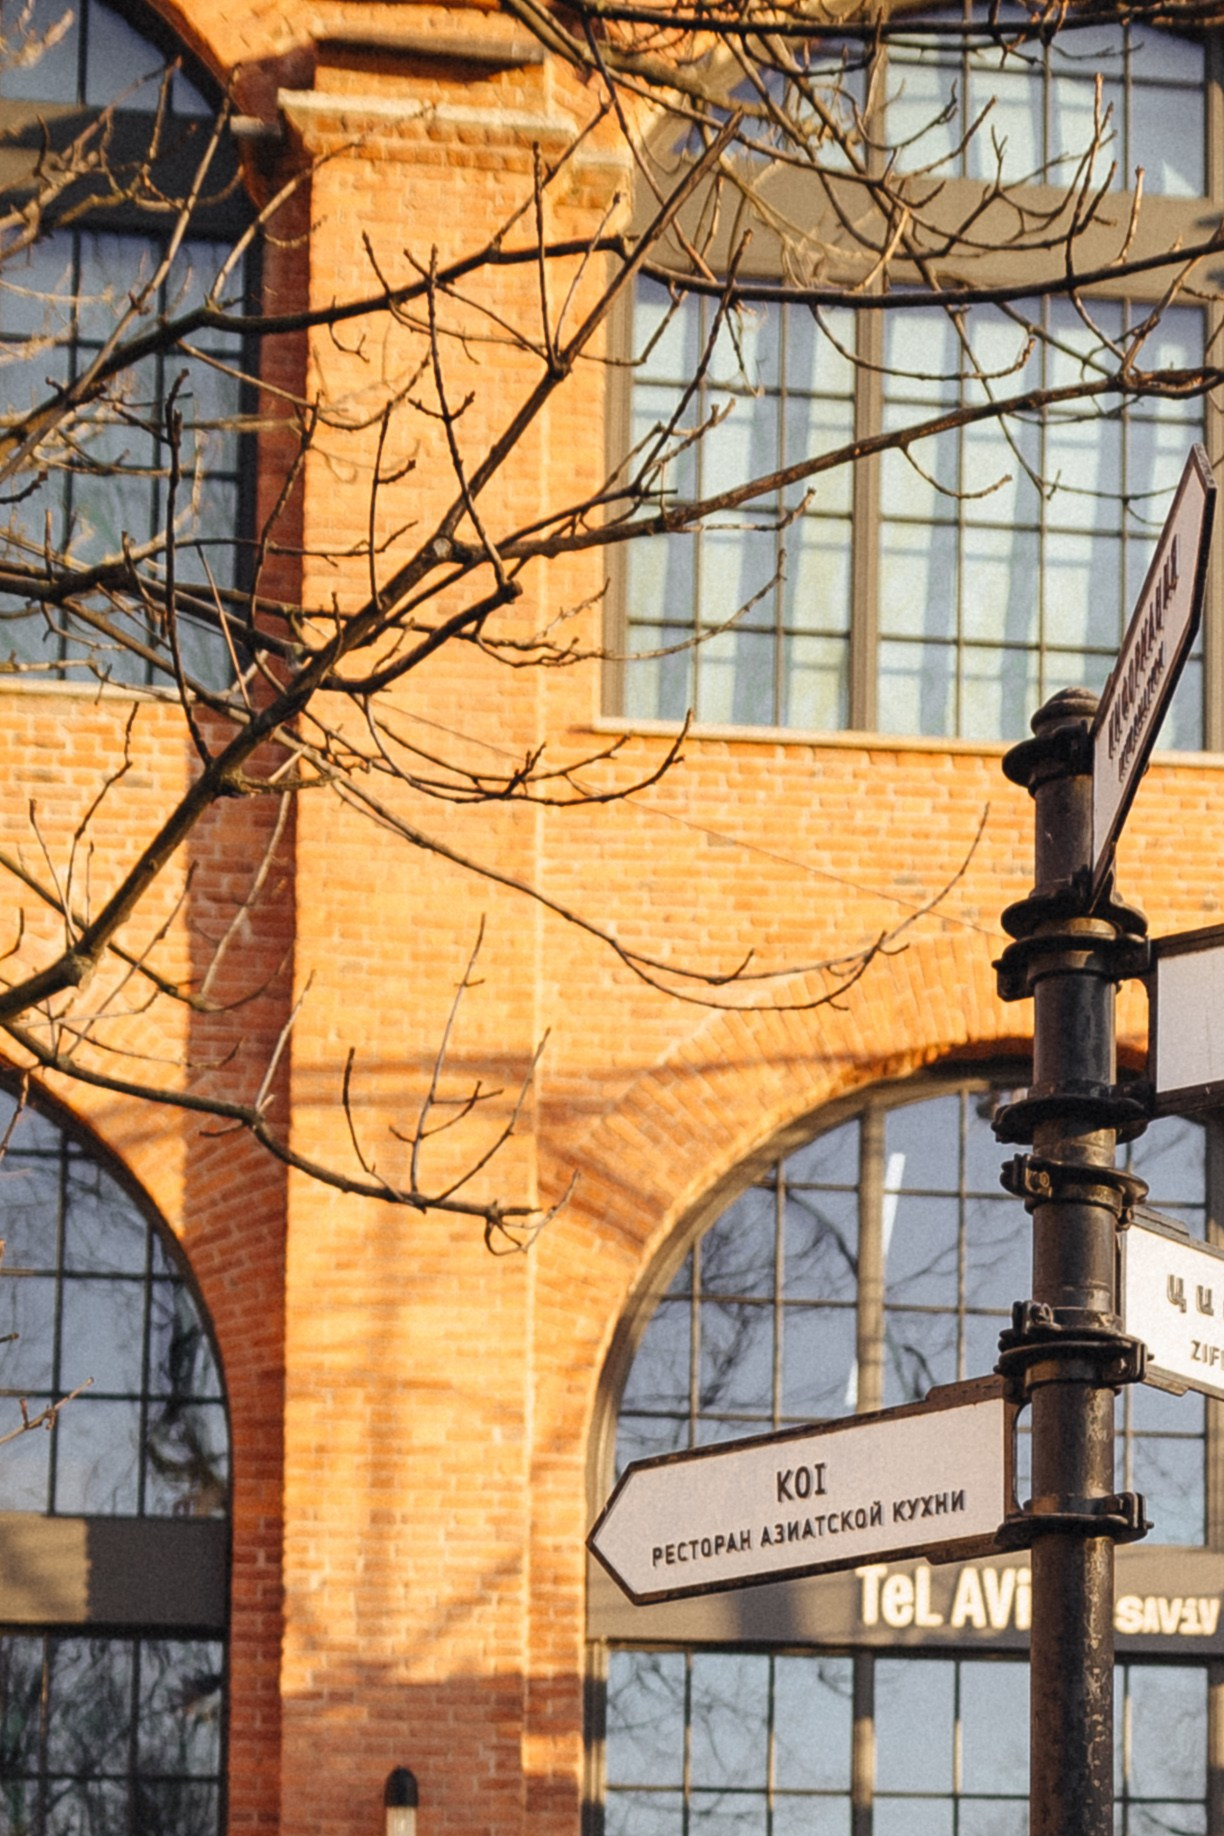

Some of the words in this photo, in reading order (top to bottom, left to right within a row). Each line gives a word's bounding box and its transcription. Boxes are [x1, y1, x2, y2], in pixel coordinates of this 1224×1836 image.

[652, 1528, 752, 1568] РЕСТОРАН
[759, 1500, 883, 1549] АЗИАТСКОЙ
[892, 1488, 967, 1525] КУХНИ
[949, 1567, 1032, 1632] AVi
